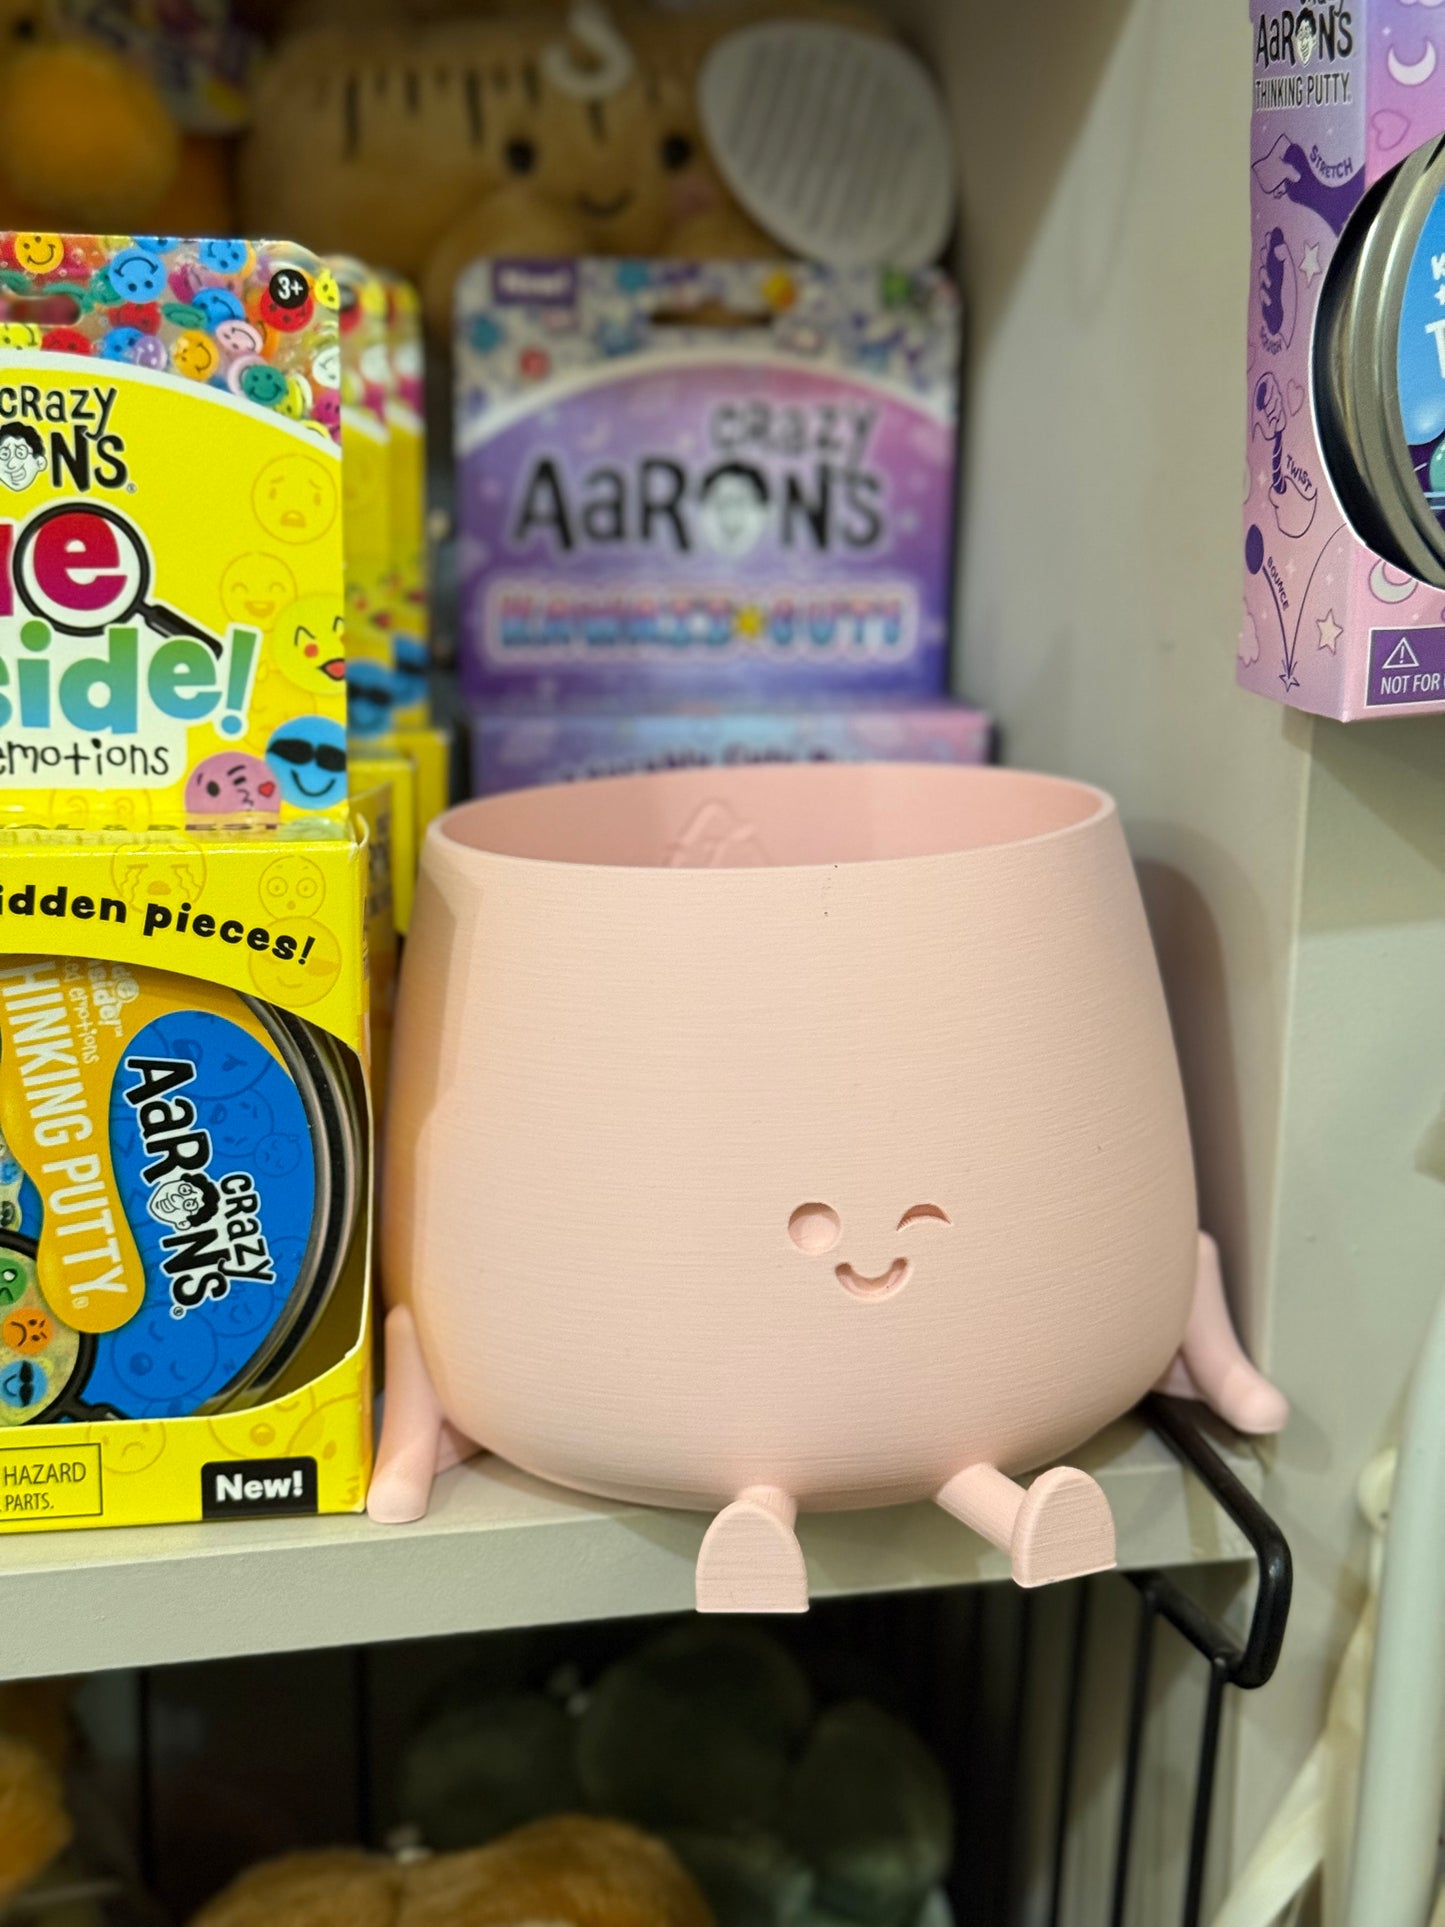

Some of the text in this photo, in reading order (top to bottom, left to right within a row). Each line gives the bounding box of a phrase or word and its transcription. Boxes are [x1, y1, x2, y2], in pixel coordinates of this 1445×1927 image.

[1256, 76, 1303, 109] THINKING
[1309, 145, 1353, 179] STRETCH
[277, 273, 304, 300] 3+
[1286, 454, 1312, 492] TWIST
[0, 620, 257, 734] ide!
[1380, 672, 1440, 695] NOT FOR
[0, 884, 315, 965] dden pieces!
[0, 958, 93, 1147] HINKING
[4, 1462, 86, 1486] HAZARD
[216, 1470, 303, 1502] New!
[5, 1492, 54, 1511] PARTS.
